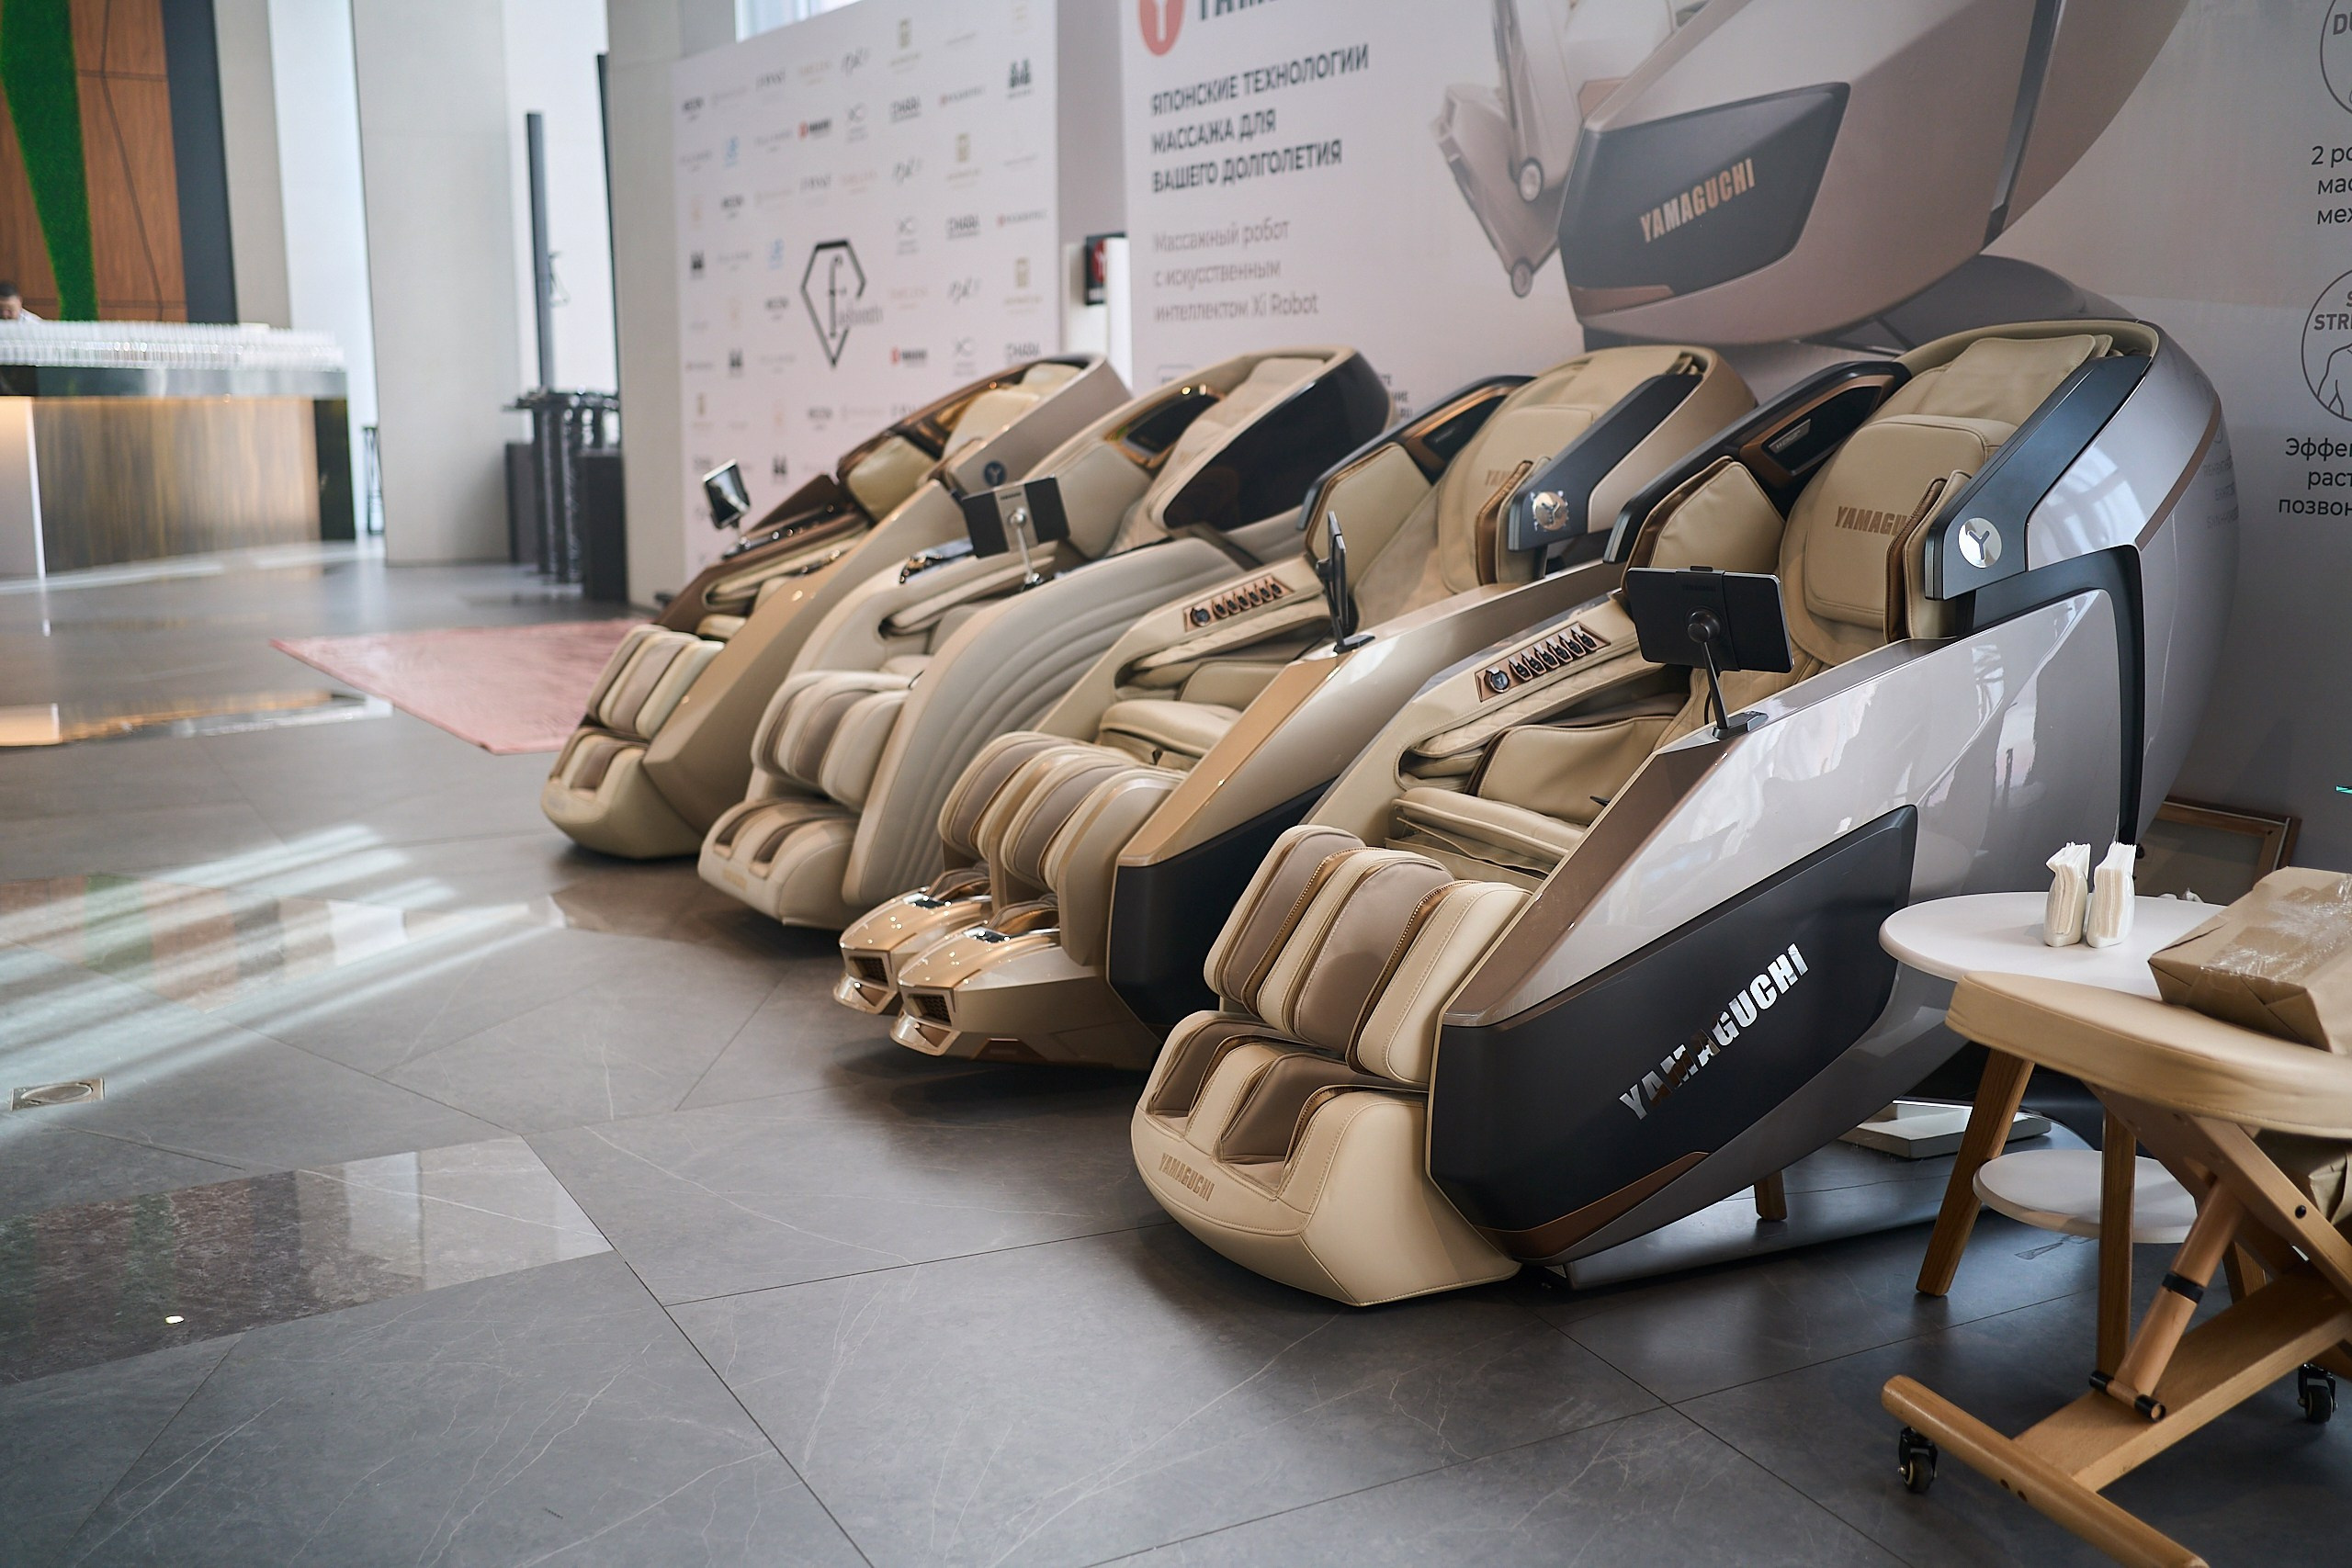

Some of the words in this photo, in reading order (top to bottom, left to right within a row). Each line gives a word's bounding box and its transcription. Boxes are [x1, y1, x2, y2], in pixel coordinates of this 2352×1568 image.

[2333, 12, 2352, 35] D
[1150, 76, 1238, 115] ЯПОНСКИЕ
[1242, 43, 1369, 96] ТЕХНОЛОГИИ
[1151, 116, 1236, 154] МАССАЖА
[1239, 108, 1276, 142] ДЛЯ
[1152, 161, 1218, 194] ВАШЕГО
[1221, 139, 1342, 186] ДОЛГОЛЕТИЯ
[2312, 145, 2324, 165] 2
[1639, 157, 1756, 243] YAMAGUCHI
[1154, 221, 1239, 253] Массажный
[1242, 217, 1290, 249] робот
[1165, 260, 1282, 290] искусственным
[1155, 299, 1248, 322] интеллектом
[1270, 292, 1318, 316] Robot
[2313, 313, 2352, 331] STR
[2285, 436, 2352, 462] Эффе
[1619, 942, 1809, 1120] YAMAGUCHI
[1159, 1152, 1216, 1202] YAMAGUCHI
